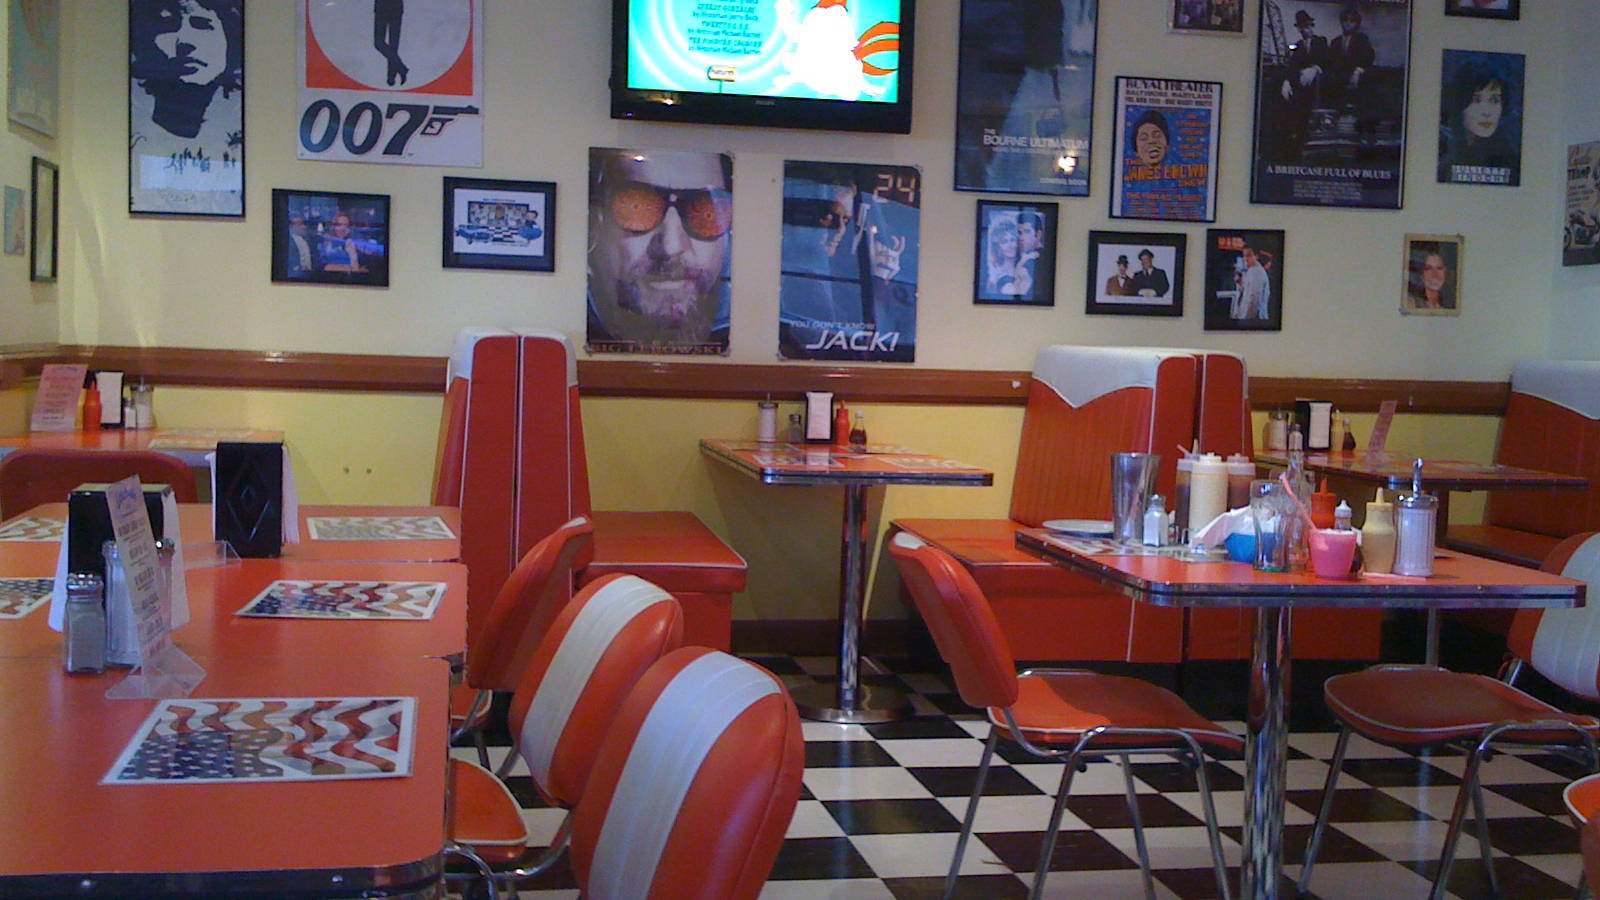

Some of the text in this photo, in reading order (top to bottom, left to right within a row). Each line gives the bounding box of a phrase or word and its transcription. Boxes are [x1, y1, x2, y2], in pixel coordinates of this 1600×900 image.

[300, 99, 430, 156] 007
[983, 134, 1027, 147] BOURNE
[873, 172, 916, 203] 24
